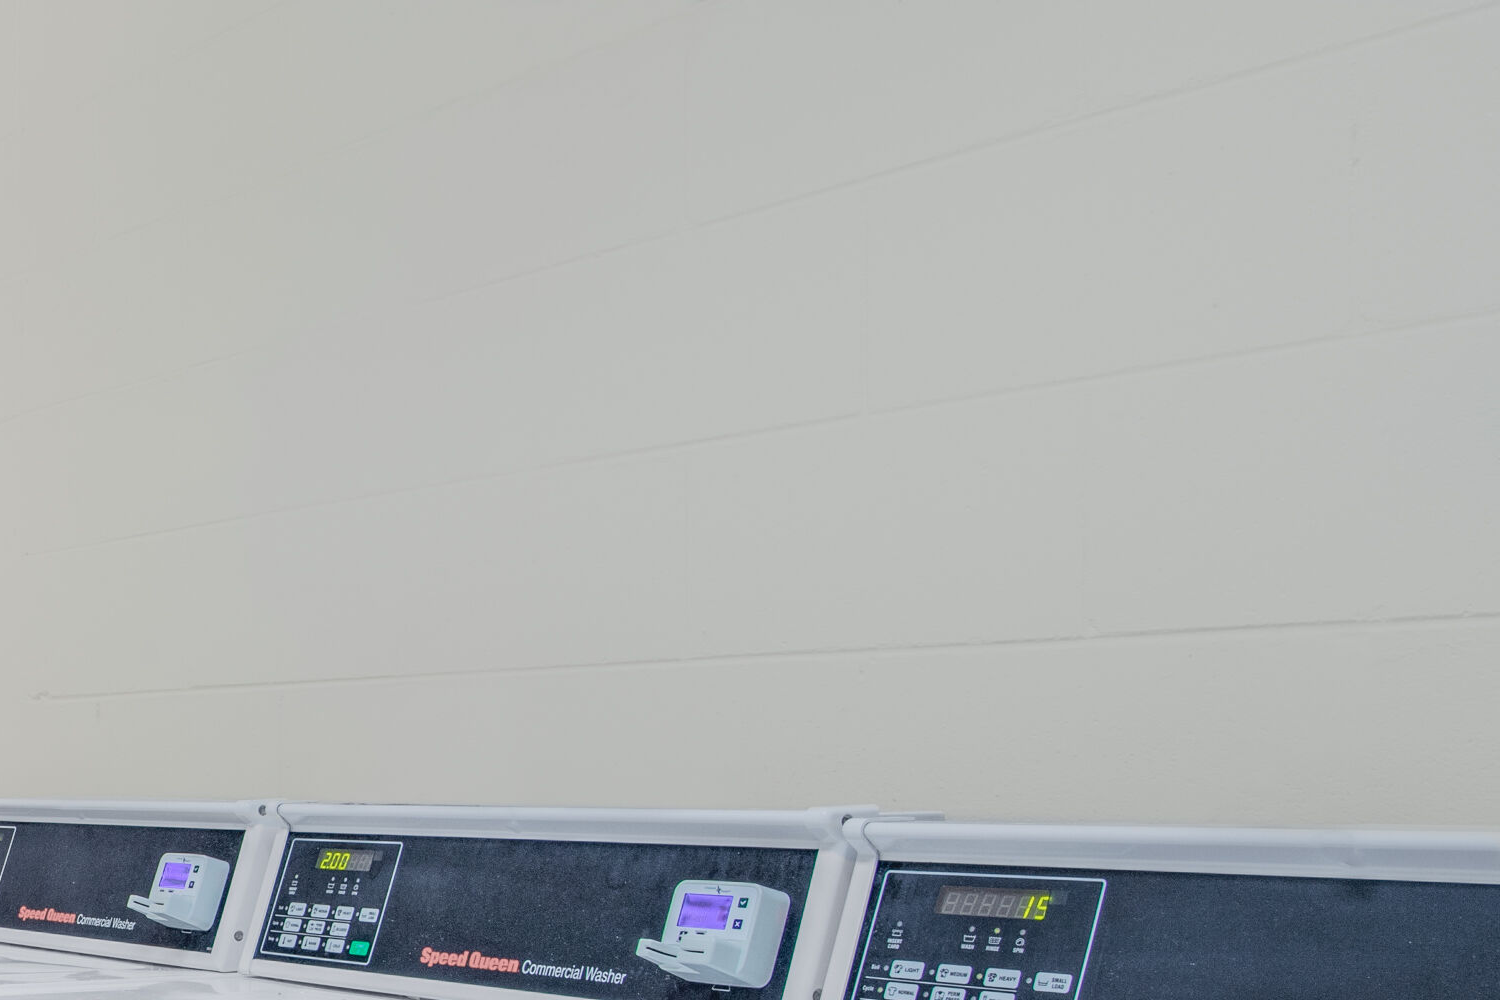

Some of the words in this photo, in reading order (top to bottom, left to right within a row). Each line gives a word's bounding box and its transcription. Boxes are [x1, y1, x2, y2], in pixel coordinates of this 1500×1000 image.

[18, 905, 48, 921] Speed
[46, 908, 77, 924] Queen
[76, 914, 113, 928] Commercial
[112, 917, 137, 930] Washer
[1023, 896, 1050, 920] 15
[420, 946, 469, 968] Speed
[469, 951, 520, 973] Queen
[521, 959, 584, 980] Commercial
[584, 966, 628, 985] Washer
